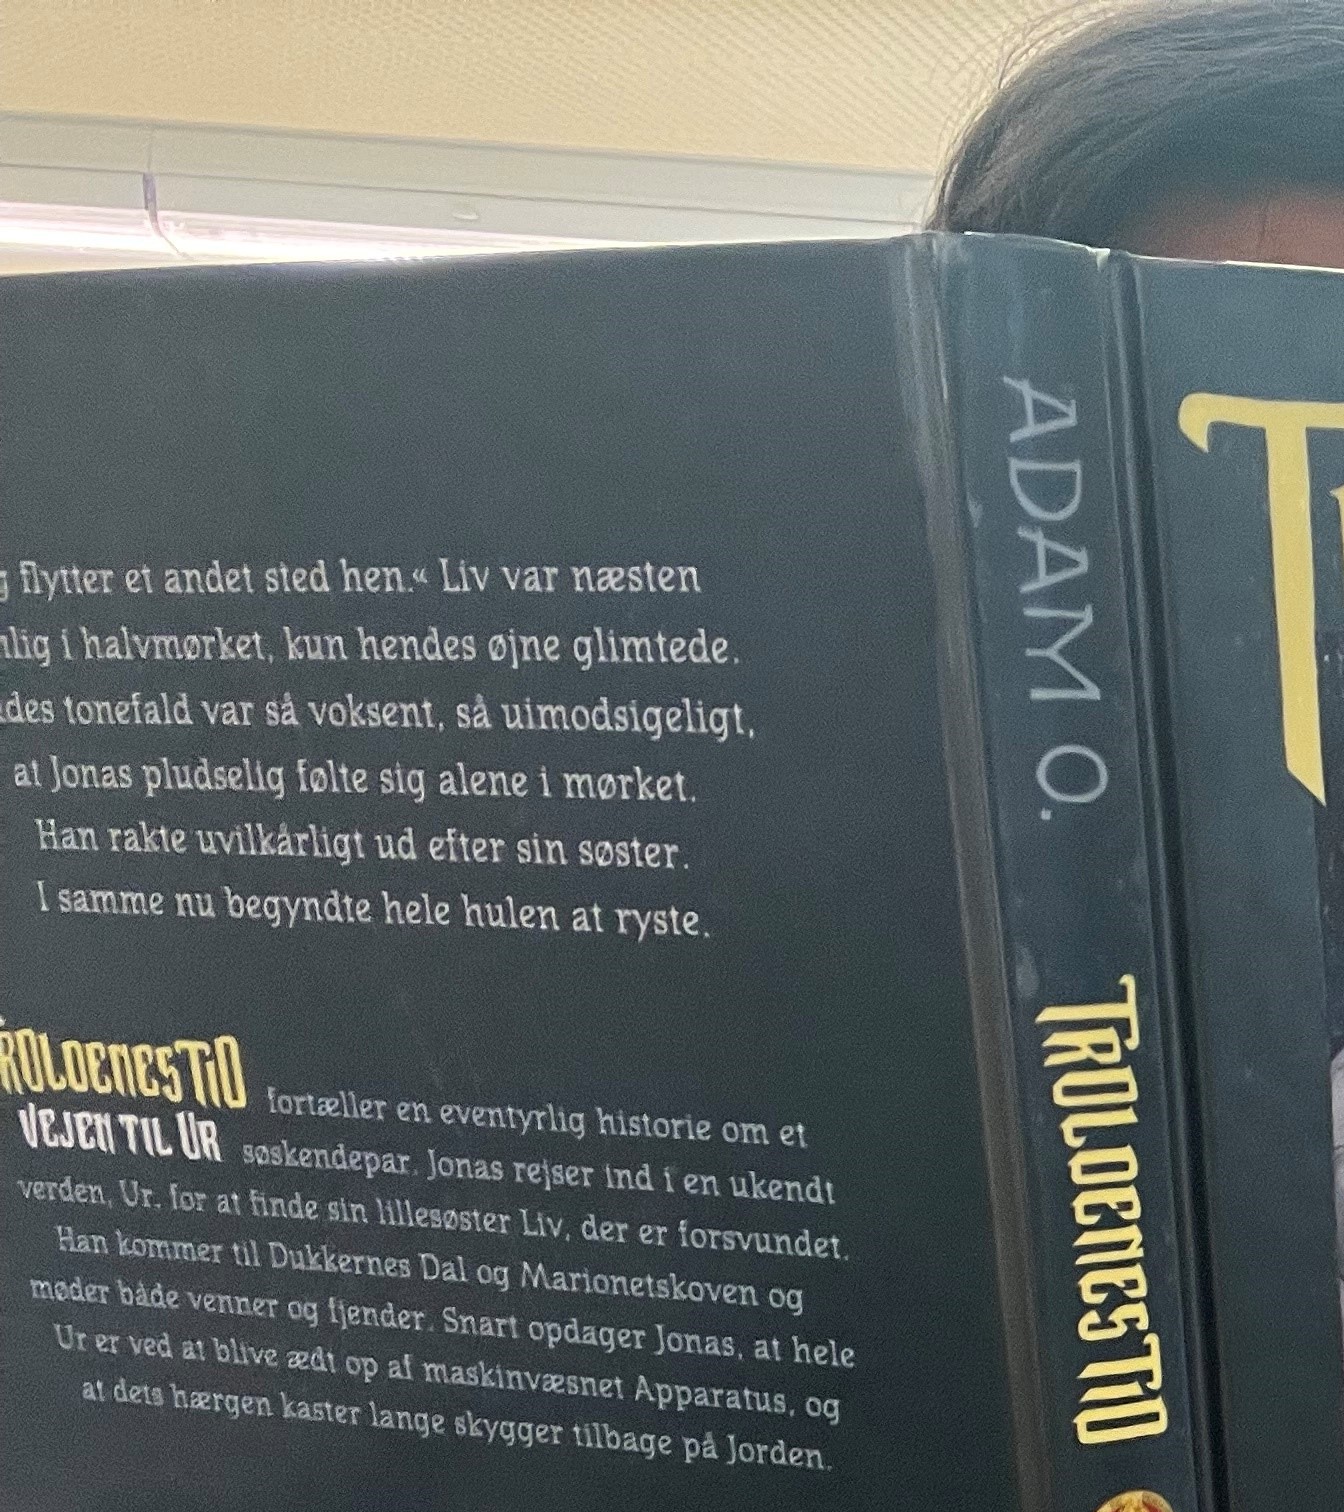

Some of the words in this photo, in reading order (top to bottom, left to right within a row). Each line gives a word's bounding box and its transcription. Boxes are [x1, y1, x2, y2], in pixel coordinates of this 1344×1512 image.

[1002, 375, 1101, 701] ADAM
[18, 558, 116, 603] flytter
[123, 563, 155, 595] et
[163, 558, 256, 596] andet
[263, 558, 333, 595] sted
[437, 556, 491, 595] Liv
[499, 564, 561, 594] var
[569, 559, 703, 594] næsten
[0, 624, 53, 669] nlig
[60, 627, 74, 661] i
[79, 624, 276, 665] halvmørket,
[281, 624, 351, 663] kun
[353, 624, 478, 663] hendes
[486, 627, 562, 671] øjne
[571, 624, 741, 672] glimtede.
[0, 689, 56, 725] des
[61, 690, 195, 727] tonefald
[199, 699, 256, 727] var
[263, 690, 303, 729] så
[306, 691, 445, 733] voksent,
[454, 692, 494, 731] så
[499, 695, 756, 745] uimodsigeligt,
[12, 761, 43, 789] at
[47, 754, 135, 795] Jonas
[140, 755, 286, 801] pludselig
[294, 756, 370, 795] følte
[378, 760, 427, 805] sig
[437, 760, 530, 799] alene
[537, 764, 554, 799] i
[560, 764, 698, 804] mørket.
[1036, 744, 1108, 821] O.
[33, 817, 101, 853] Han
[106, 819, 189, 855] rakte
[194, 820, 367, 868] uvilkårligt
[373, 825, 420, 863] ud
[427, 826, 507, 865] efter
[515, 831, 570, 867] sin
[577, 834, 690, 871] søster.
[32, 879, 51, 913] I
[56, 887, 165, 917] samme
[173, 891, 217, 920] nu
[220, 884, 374, 930] begyndte
[379, 889, 452, 928] hele
[459, 892, 562, 933] hulen
[570, 901, 606, 935] at
[612, 904, 712, 944] ryste.
[0, 1016, 183, 1103] ROLDENES
[18, 1102, 116, 1155] VEJEN
[118, 1114, 173, 1158] TIL
[175, 1110, 224, 1163] UR
[265, 1086, 389, 1122] fortæller
[395, 1101, 434, 1125] en
[438, 1103, 587, 1142] eventyrlig
[594, 1106, 713, 1142] historie
[720, 1121, 771, 1147] om
[778, 1122, 809, 1150] et
[241, 1139, 420, 1181] søskendepar.
[426, 1148, 505, 1182] Jonas
[511, 1158, 596, 1193] rejser
[602, 1163, 656, 1193] ind
[662, 1166, 676, 1194] i
[682, 1173, 722, 1198] en
[728, 1170, 837, 1206] ukendt
